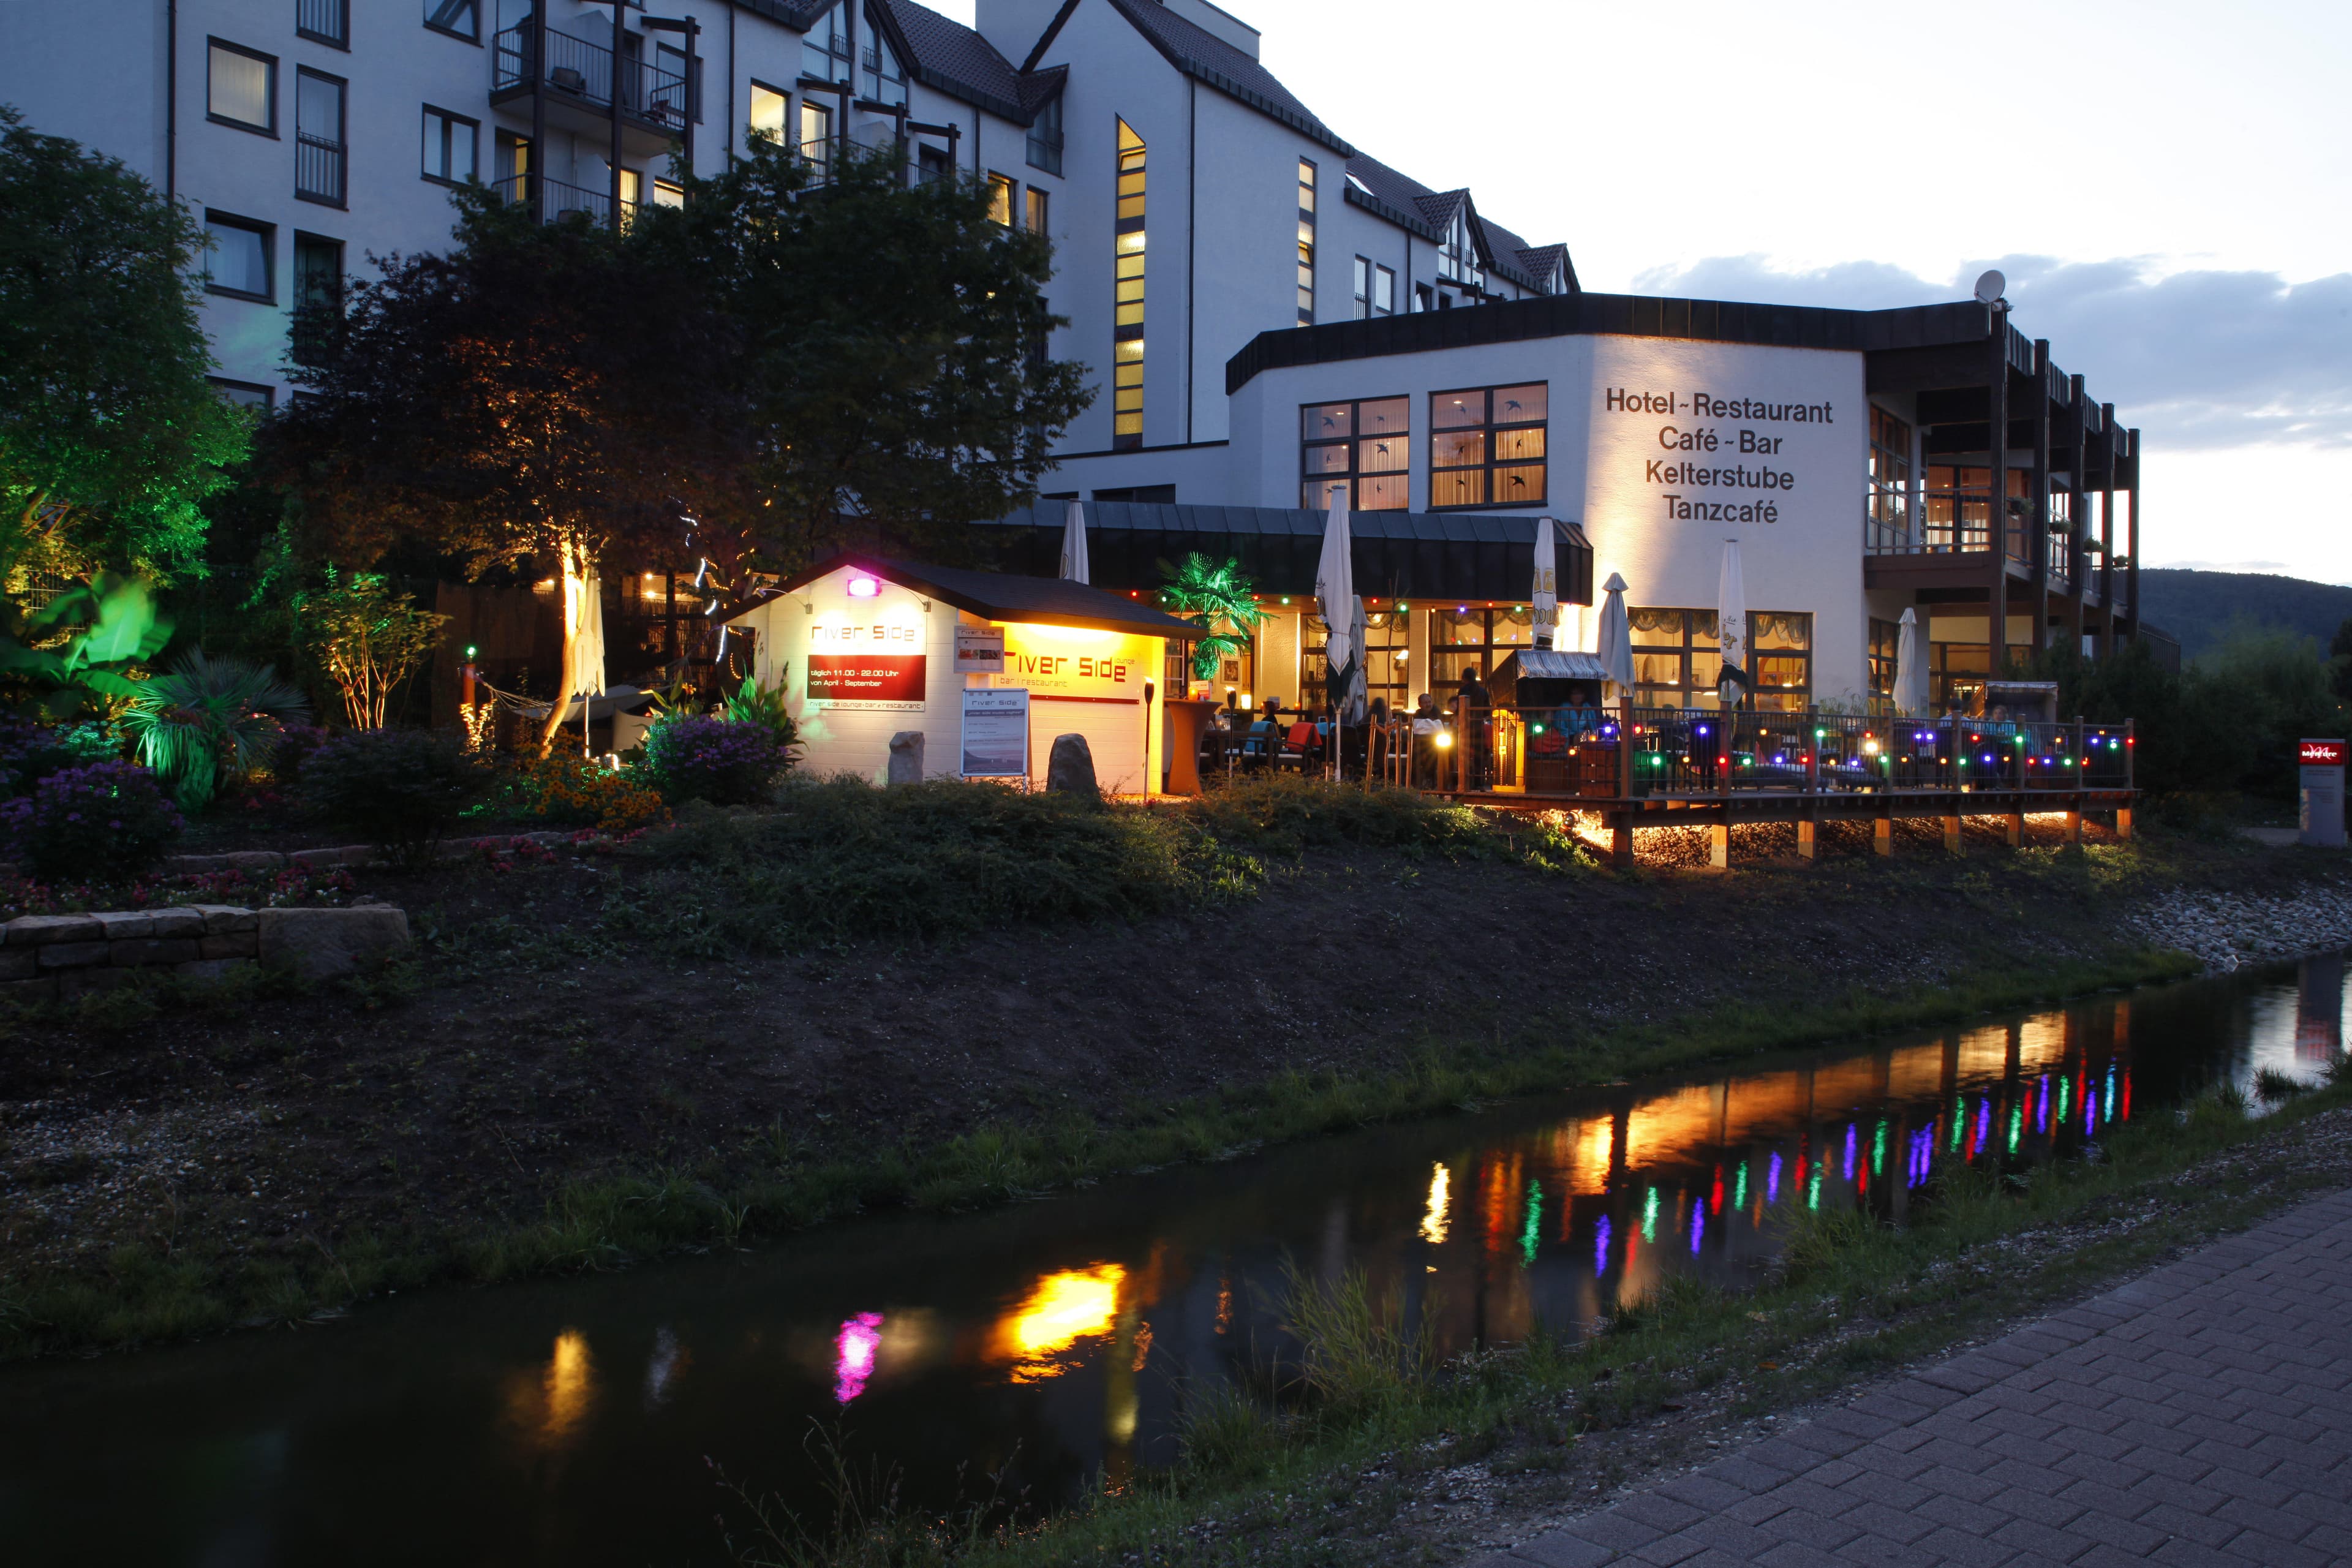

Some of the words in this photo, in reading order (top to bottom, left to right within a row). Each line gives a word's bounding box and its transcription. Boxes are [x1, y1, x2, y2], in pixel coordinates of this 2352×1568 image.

[1606, 388, 1675, 414] Hotel
[1694, 393, 1833, 424] Restaurant
[1659, 426, 1719, 451] Café
[1740, 430, 1783, 454] Bar
[1646, 460, 1795, 491] Kelterstube
[1662, 495, 1778, 524] Tanzcafé
[812, 627, 864, 639] river
